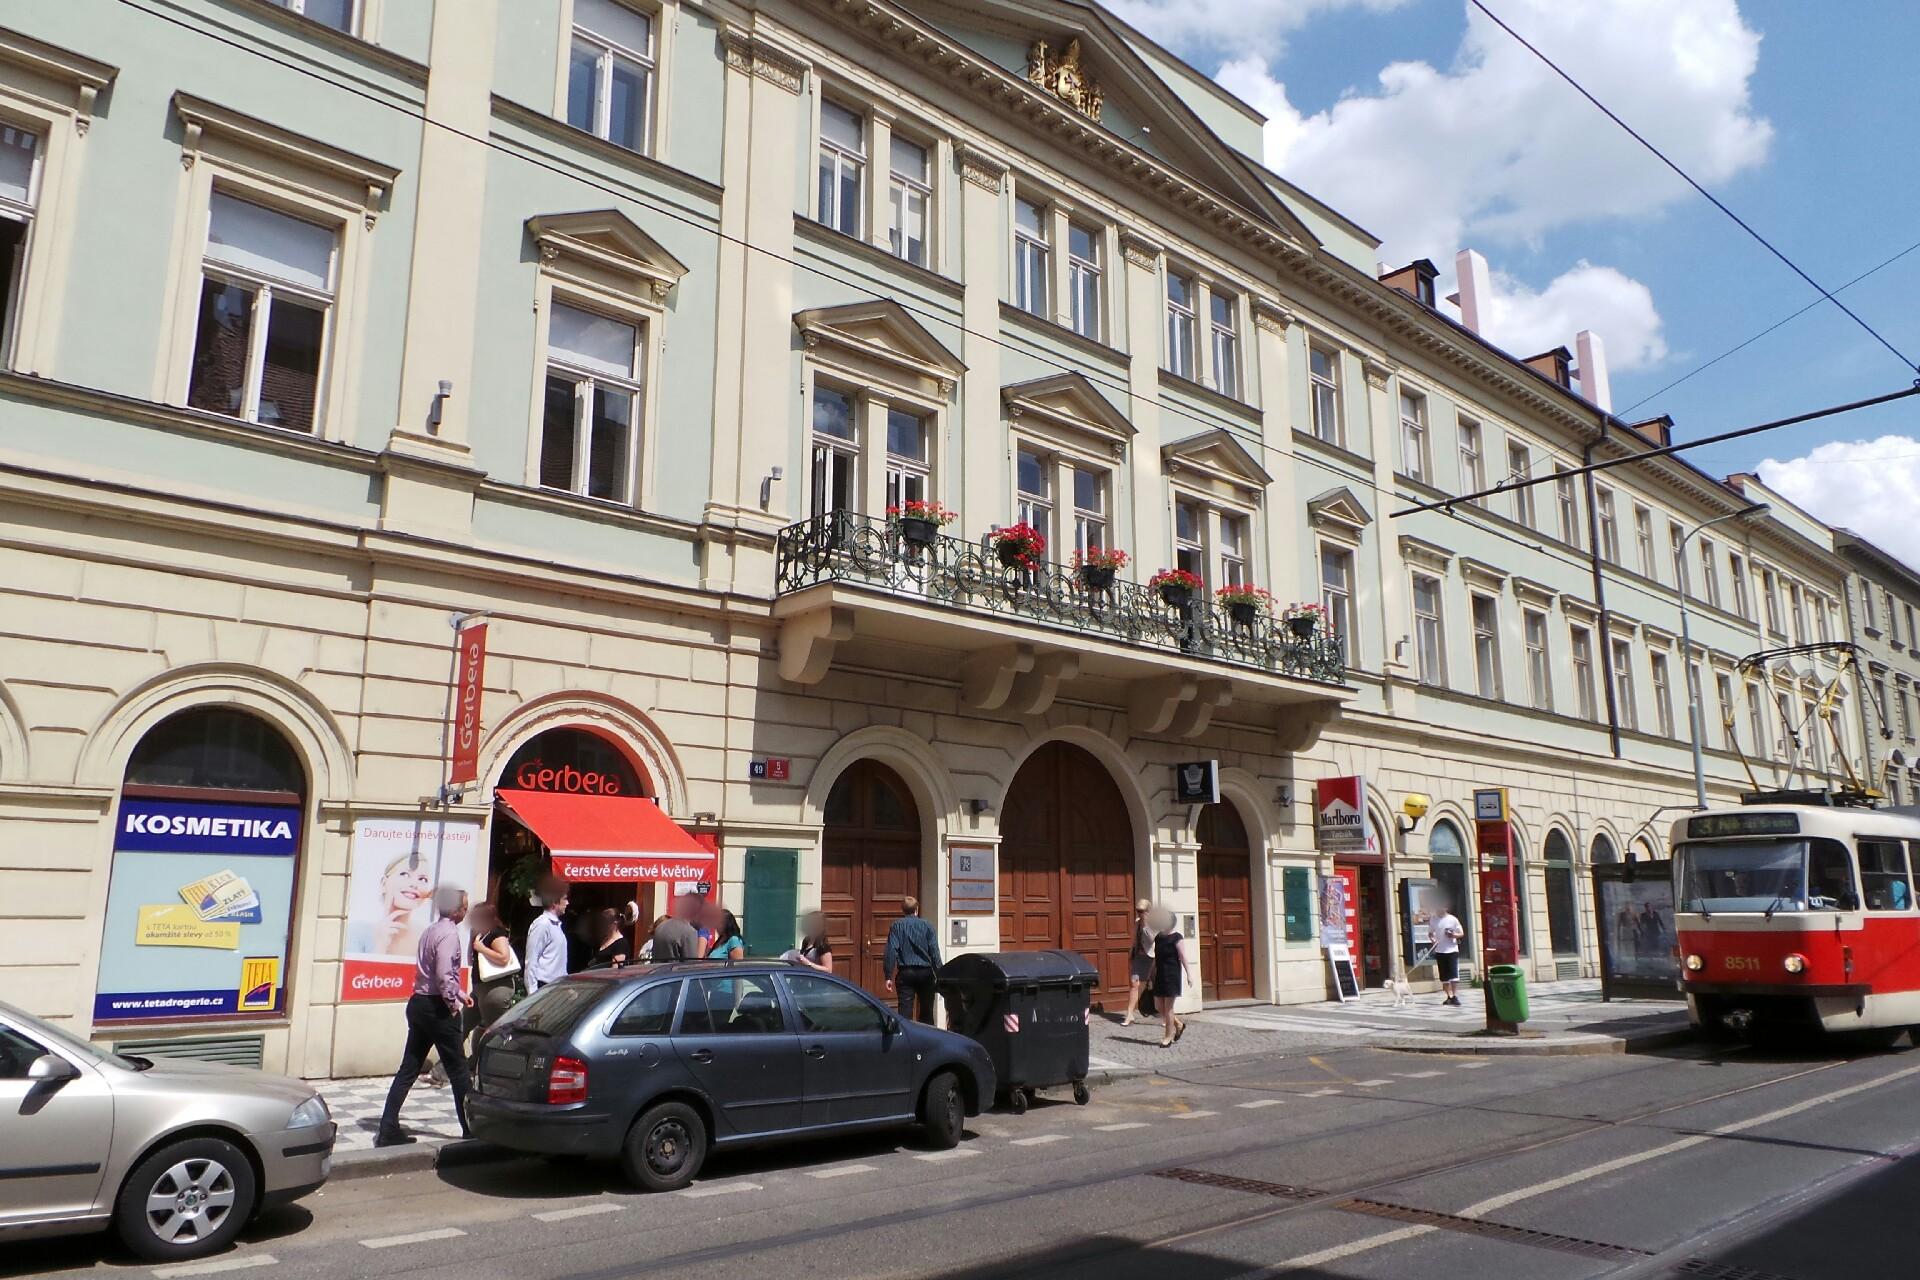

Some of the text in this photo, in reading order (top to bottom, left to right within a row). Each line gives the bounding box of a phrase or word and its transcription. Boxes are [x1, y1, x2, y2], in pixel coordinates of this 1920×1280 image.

[460, 643, 479, 749] Gerbera
[754, 764, 763, 774] 49
[776, 761, 781, 771] 5
[517, 758, 622, 794] Gerbera
[1320, 809, 1361, 826] Marlboro
[125, 814, 292, 839] KOSMETIKA
[363, 827, 403, 840] Darujte
[564, 864, 704, 880] čerstvě čerstvé květiny
[1726, 956, 1760, 970] 8511
[352, 974, 403, 989] Gerbera
[112, 997, 224, 1009] www.tetadrogerie.cz
